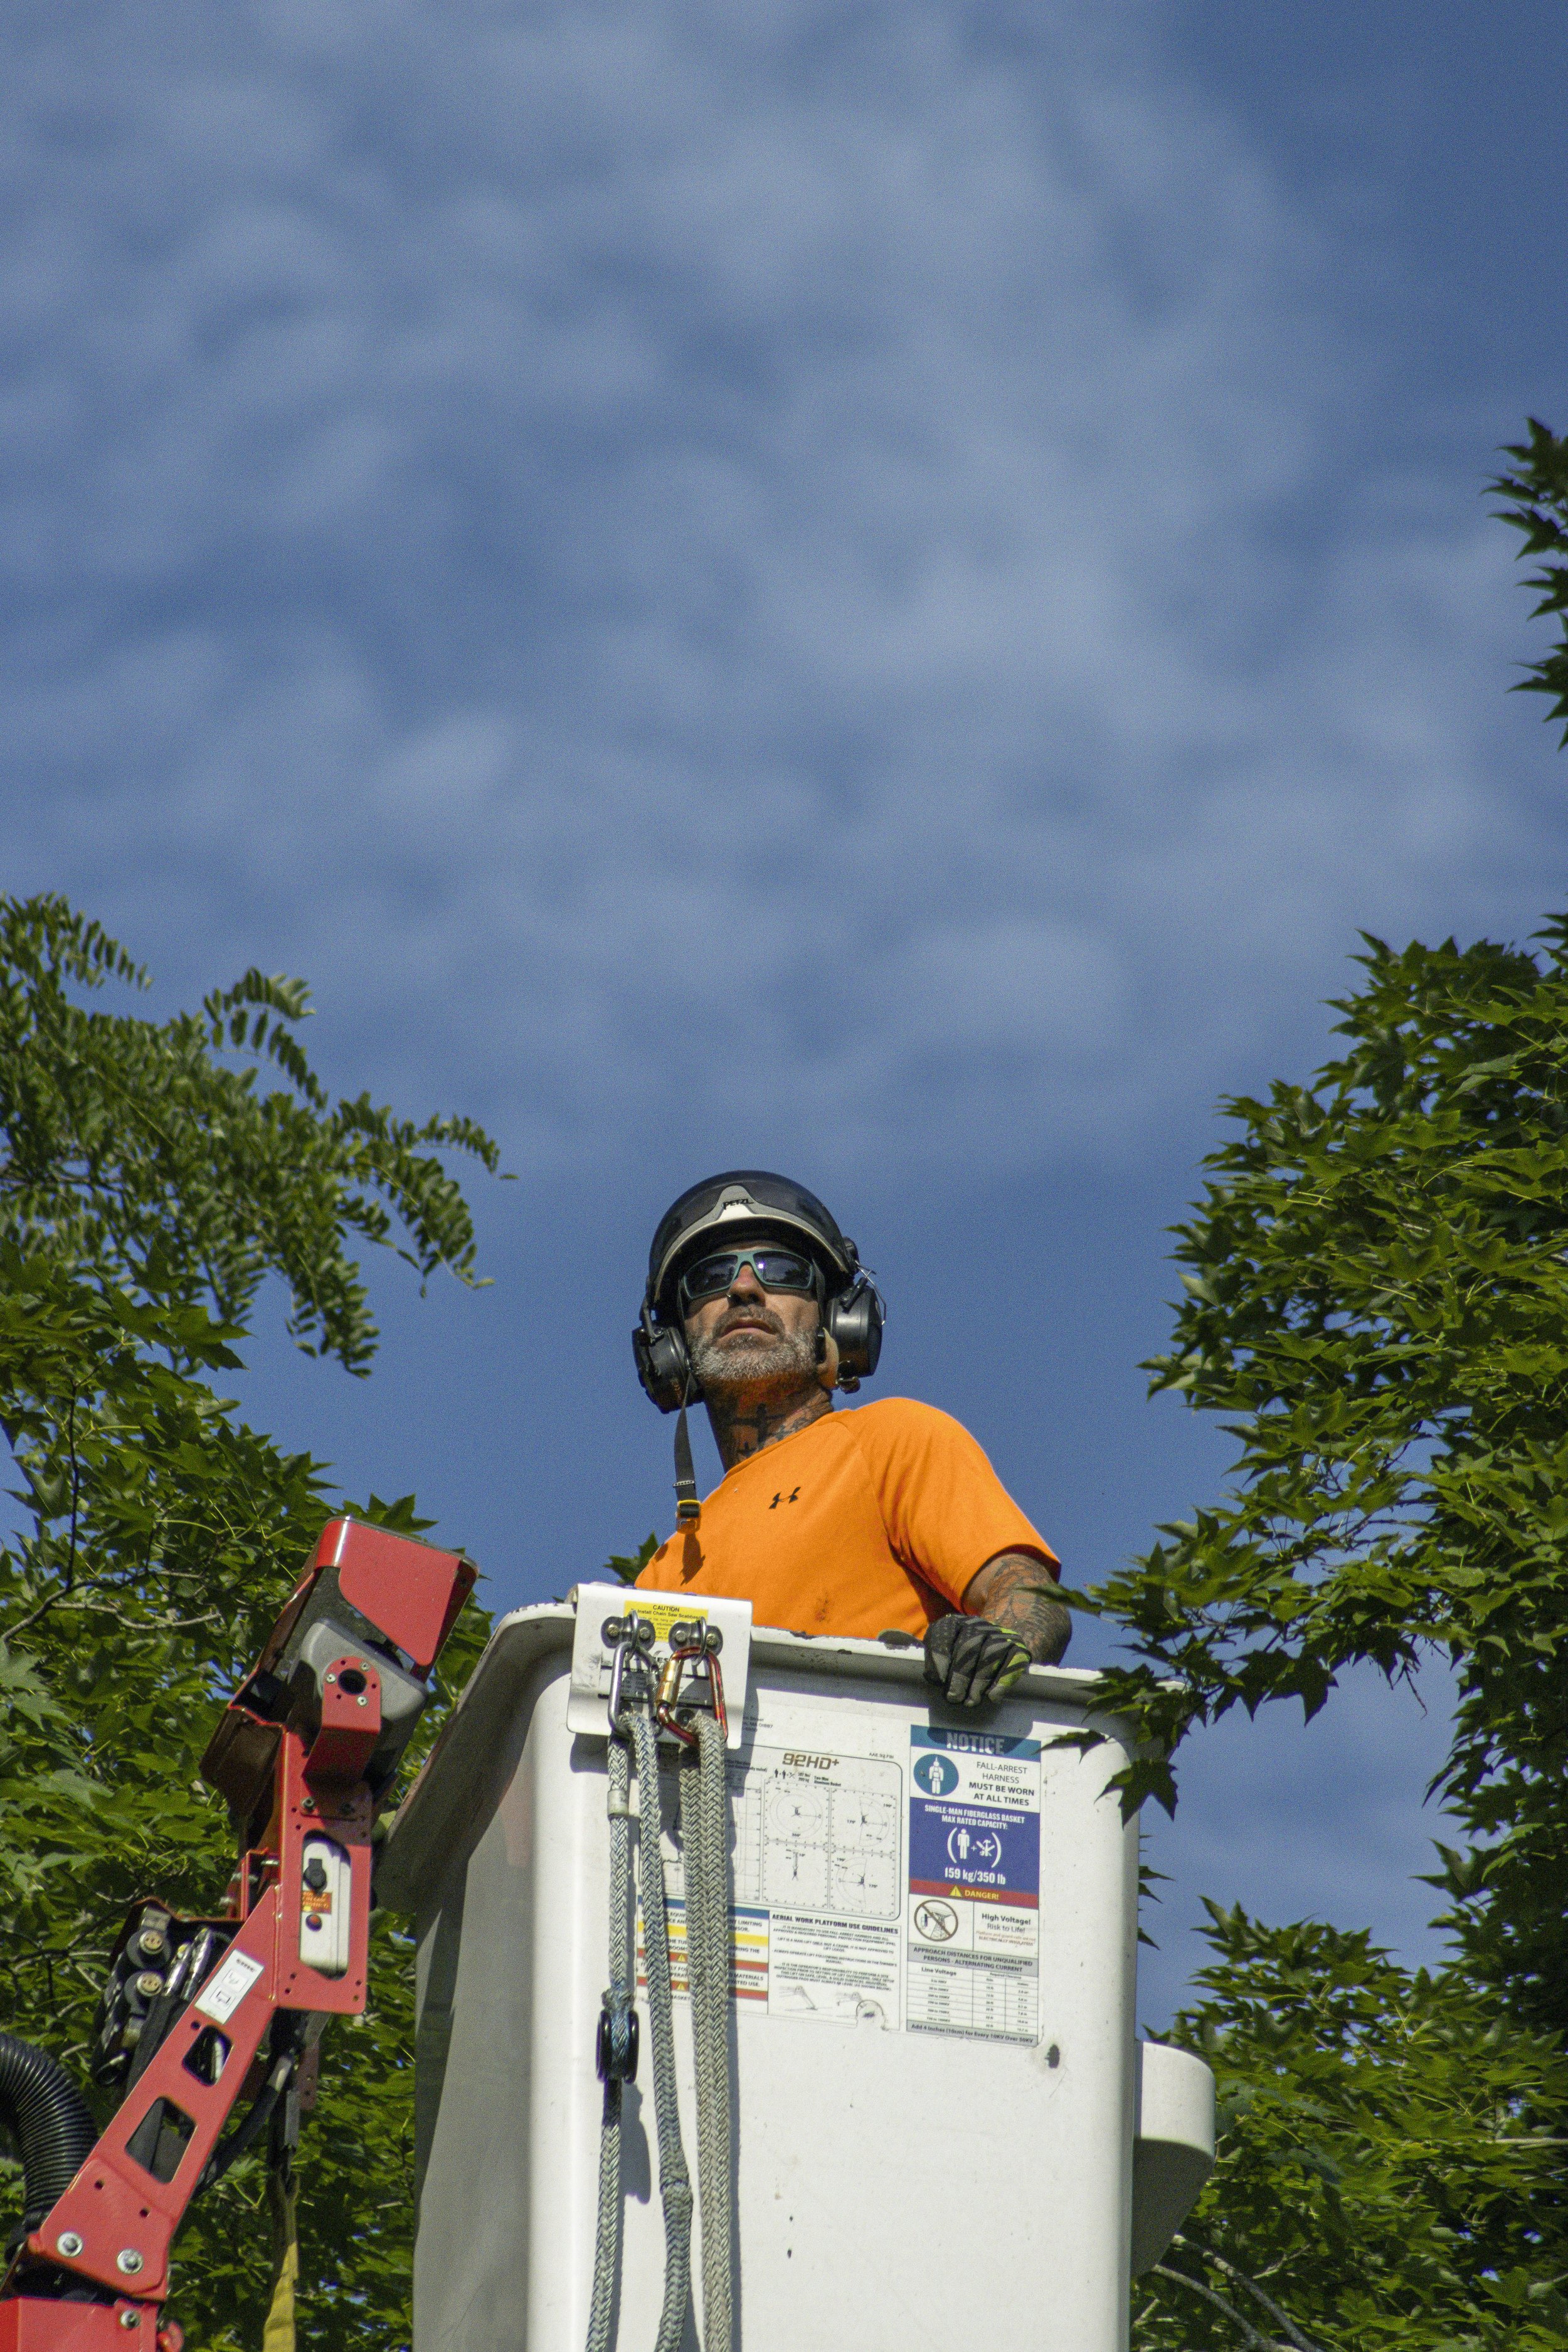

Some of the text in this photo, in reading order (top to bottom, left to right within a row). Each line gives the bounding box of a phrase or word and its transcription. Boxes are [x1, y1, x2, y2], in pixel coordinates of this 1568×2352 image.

[722, 1199, 754, 1210] PETZL
[946, 1732, 1005, 1755] NOTICE
[782, 1752, 839, 1770] 92HD+
[977, 1761, 1027, 1774] FALL-ARREST
[982, 1773, 1019, 1784] HARNESS
[969, 1782, 1034, 1796] MUST BE WORN
[986, 1794, 1002, 1803] ALL
[1004, 1797, 1029, 1806] TIMES
[924, 1805, 1025, 1824] SINGLE-MAN FIBERGLASS BASKET
[942, 1815, 1008, 1830] MAX RATED CAPACITY:
[945, 1867, 1006, 1885] 159 kg/350 lb
[965, 1889, 1000, 1900] DANGER!
[982, 1913, 1031, 1925] High Voltage!
[815, 1919, 847, 1927] PLATFORM
[862, 1925, 898, 1934] GUIDELINES
[914, 1947, 945, 1956] APPROACH
[946, 1951, 978, 1959] DISTANCES
[993, 1956, 1032, 1966] UNQUALIFIED
[923, 1955, 950, 1963] PERSONS
[955, 1959, 993, 1969] ALTERNATING
[995, 1964, 1022, 1972] CURRENT
[935, 1968, 956, 1976] Voltage
